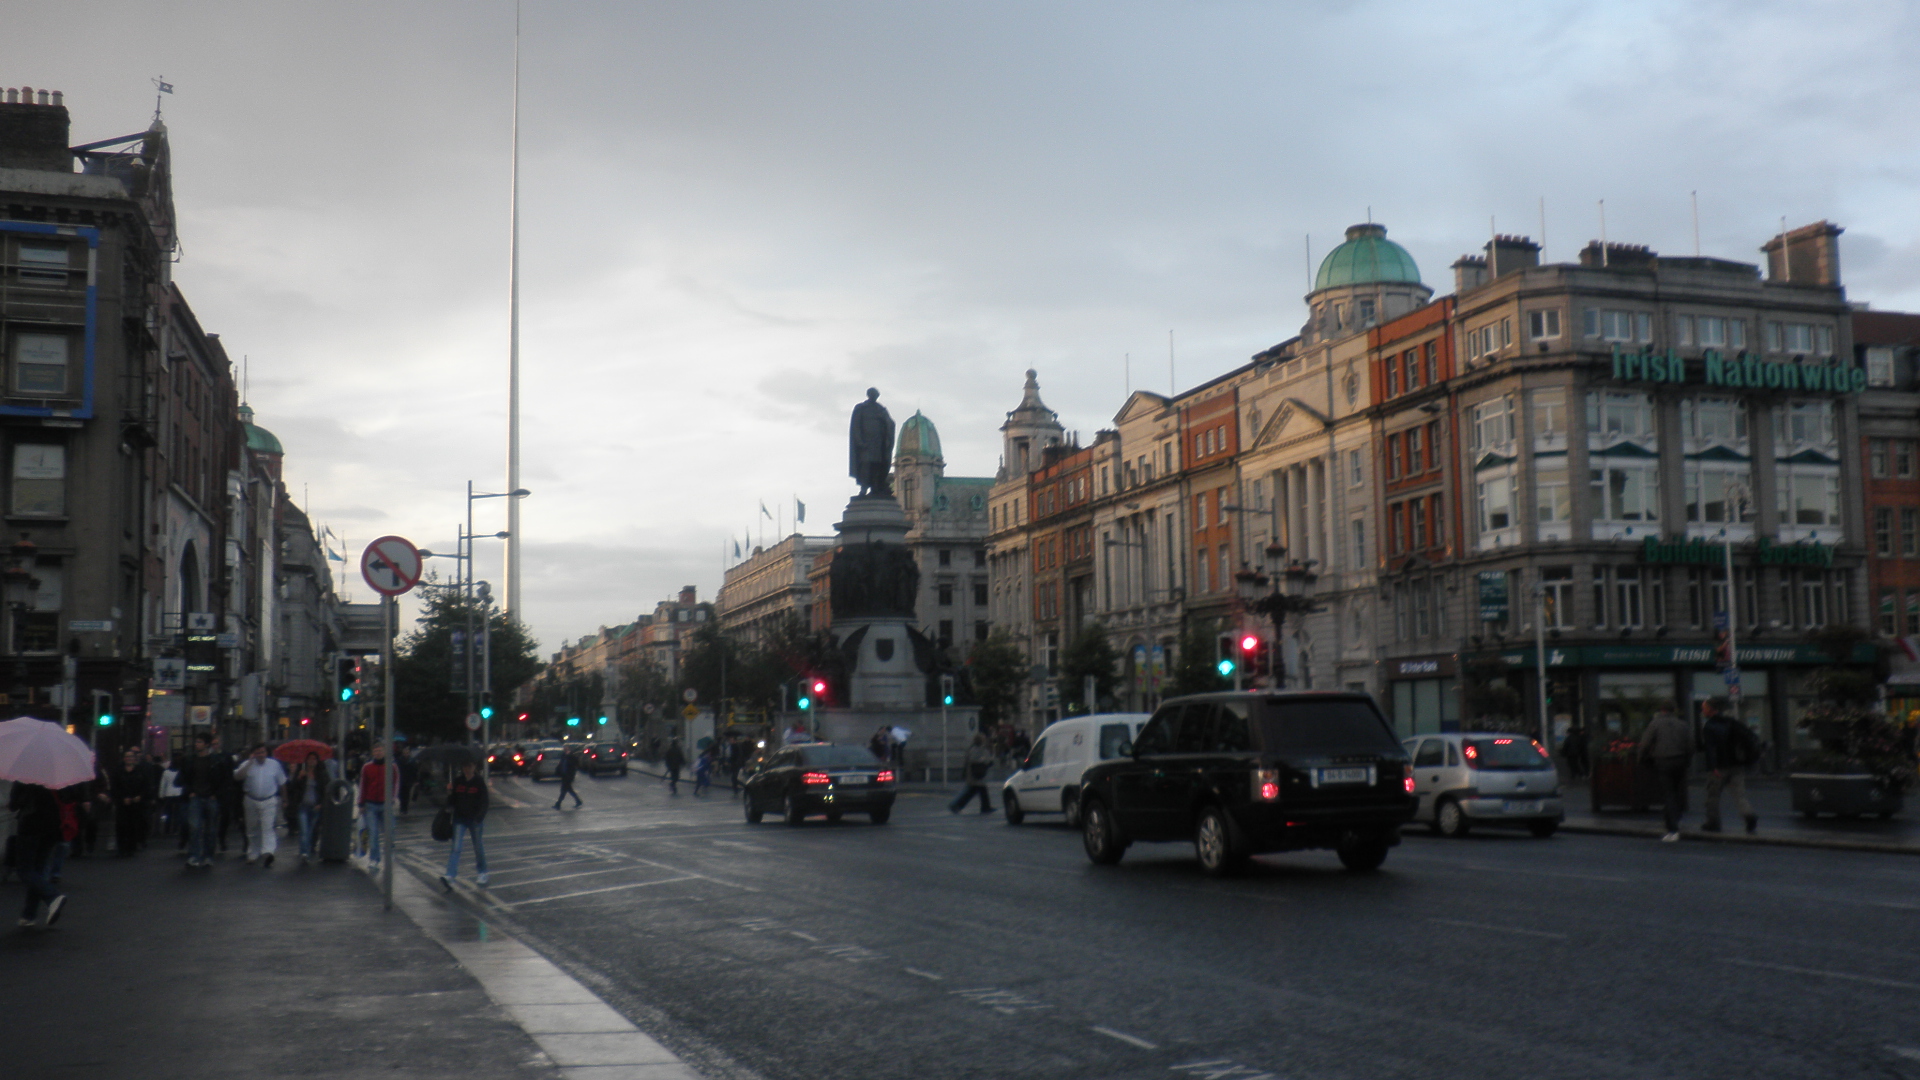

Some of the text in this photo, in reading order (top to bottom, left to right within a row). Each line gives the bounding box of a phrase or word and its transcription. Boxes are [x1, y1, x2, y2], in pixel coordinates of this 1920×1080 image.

[1612, 343, 1868, 394] Irish Nationwide
[1759, 537, 1834, 568] Society
[1671, 647, 1711, 661] IRISH
[1730, 647, 1796, 661] TIONWIDE
